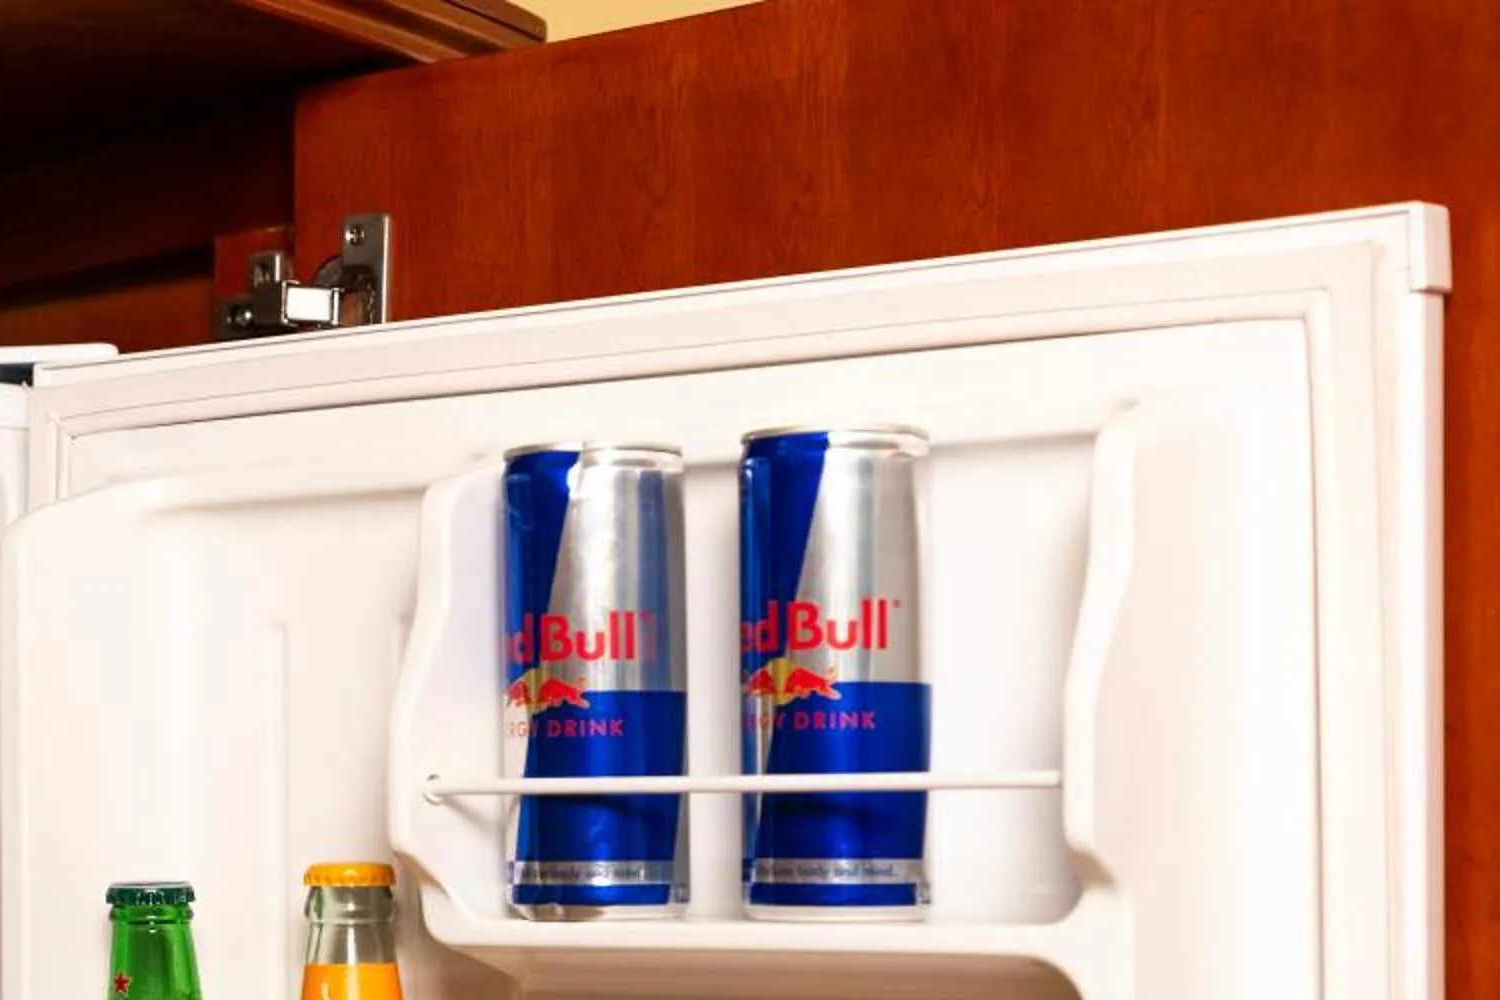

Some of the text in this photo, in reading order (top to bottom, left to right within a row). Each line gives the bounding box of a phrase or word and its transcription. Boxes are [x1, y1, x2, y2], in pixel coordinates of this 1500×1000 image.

[506, 610, 635, 664] d Bull
[787, 596, 888, 651] Bull
[547, 718, 624, 738] DRINK
[792, 711, 876, 730] DRINK
